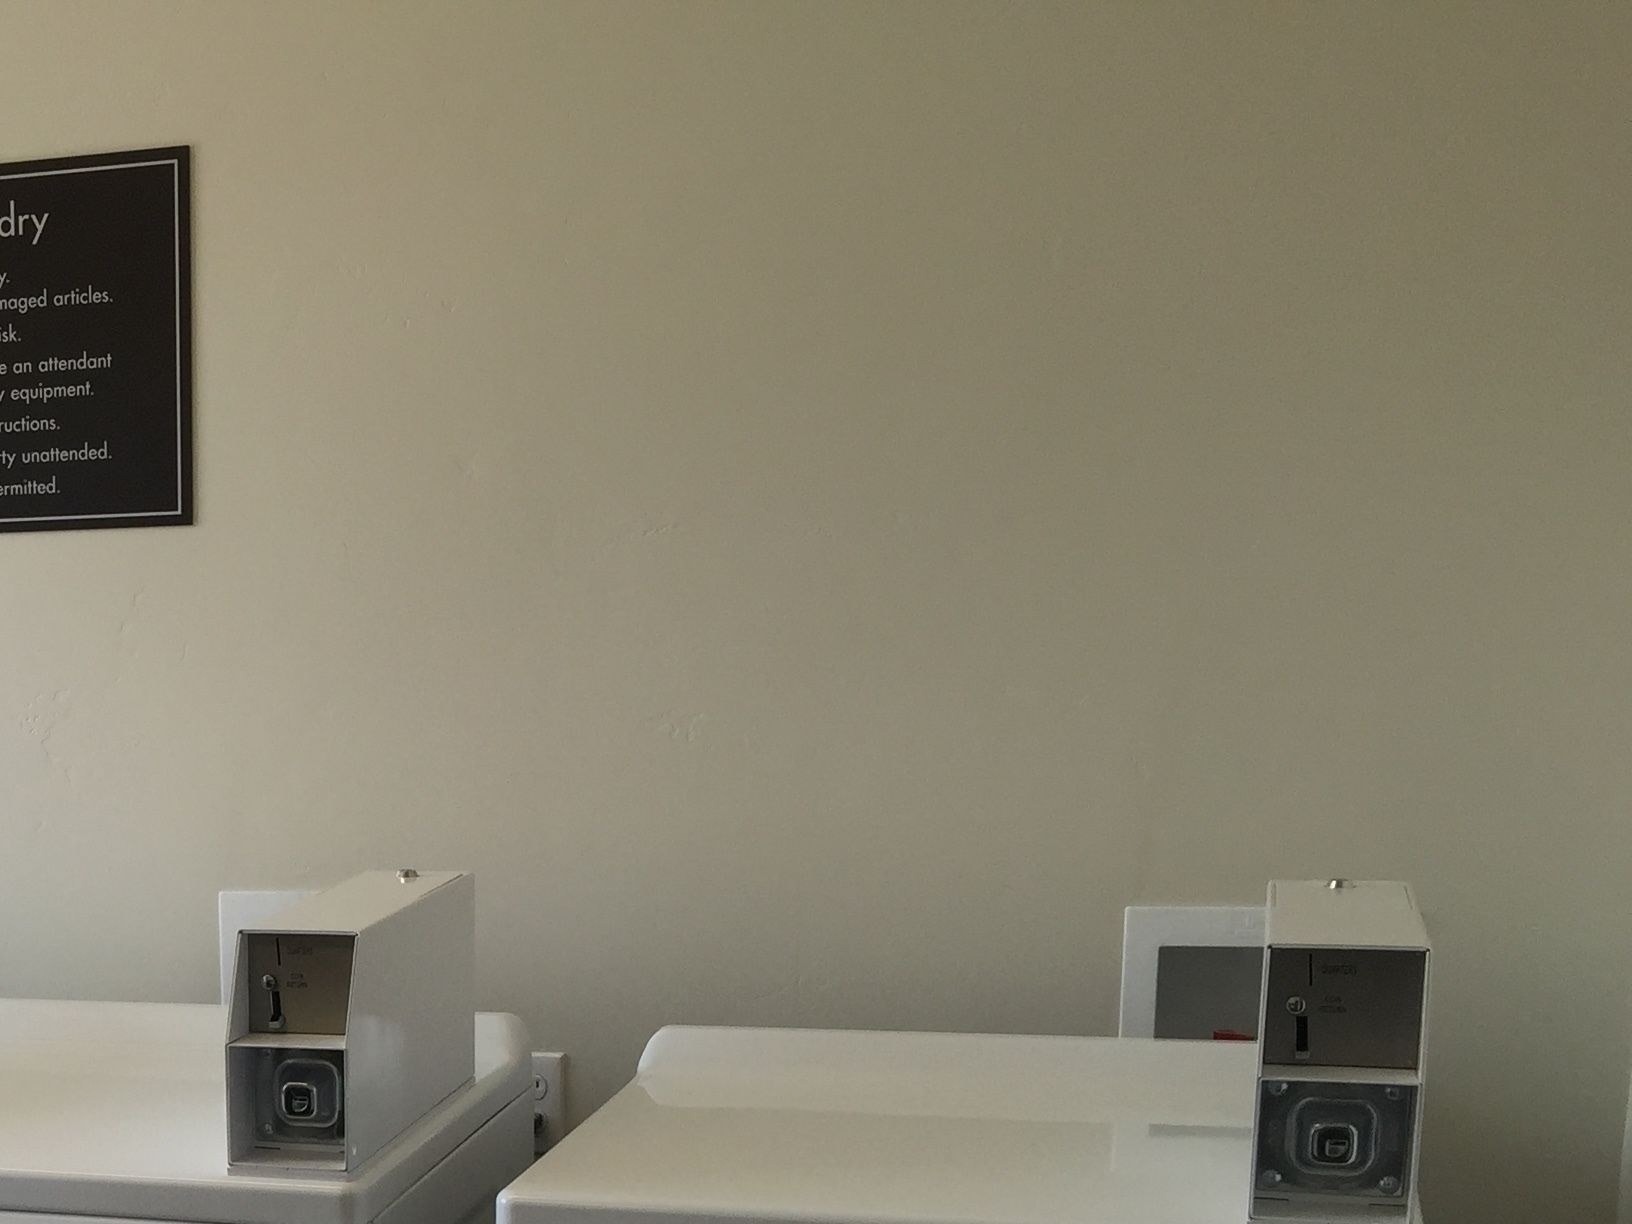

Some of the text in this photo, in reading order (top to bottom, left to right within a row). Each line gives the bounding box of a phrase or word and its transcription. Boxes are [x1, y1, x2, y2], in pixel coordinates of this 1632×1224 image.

[53, 285, 113, 306] articles.
[12, 362, 32, 374] an
[38, 350, 112, 373] attendant
[10, 381, 94, 405] equipment.
[22, 440, 112, 464] unattended.
